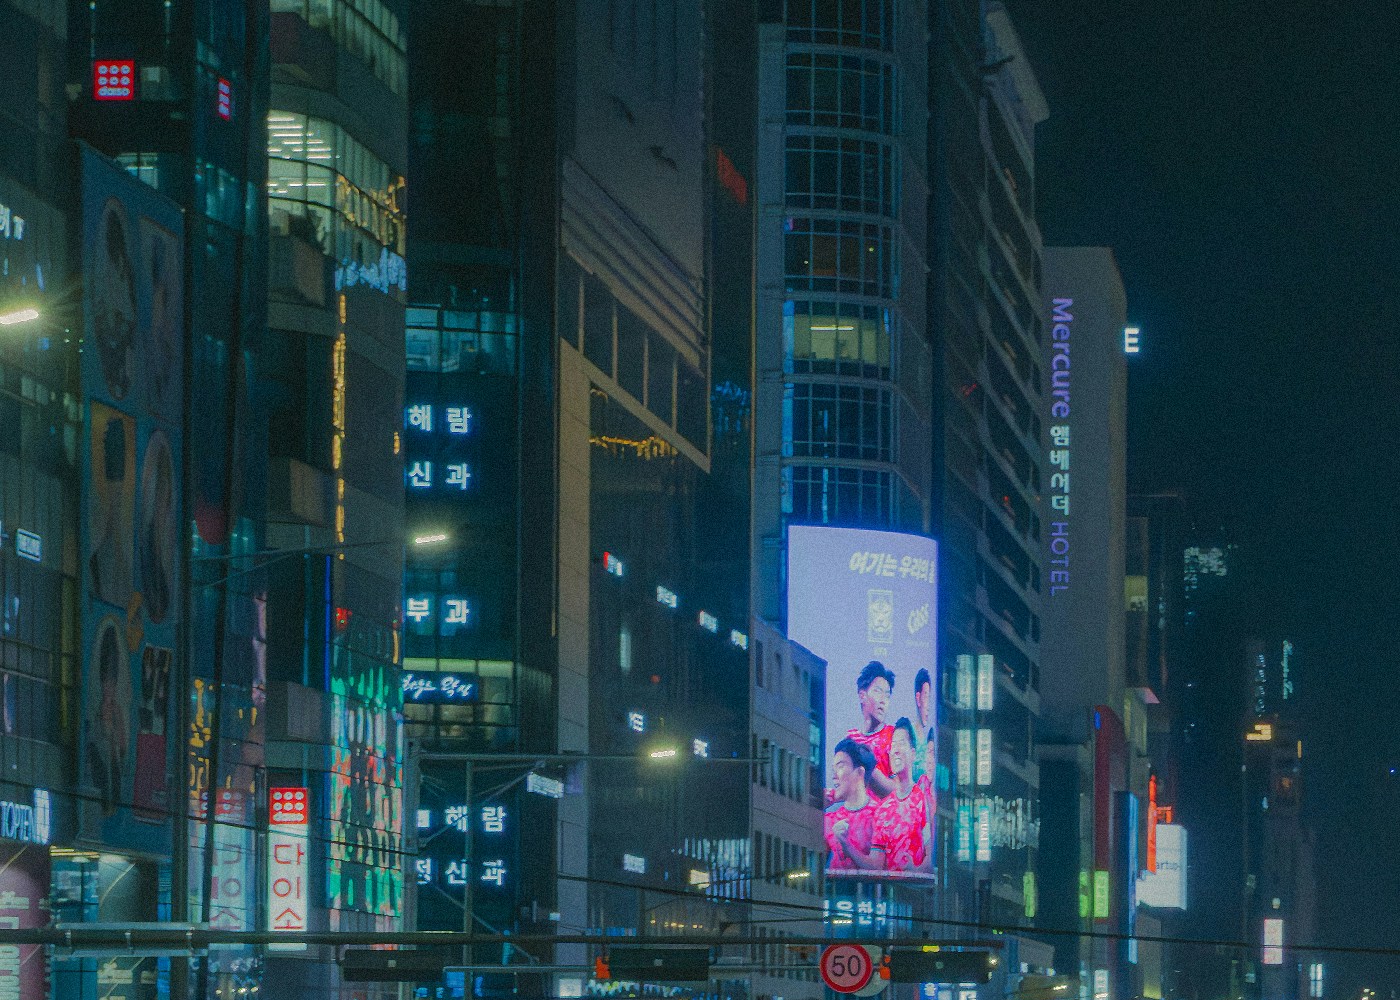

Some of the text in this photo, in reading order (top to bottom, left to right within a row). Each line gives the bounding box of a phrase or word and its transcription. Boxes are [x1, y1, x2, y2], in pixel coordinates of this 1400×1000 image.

[1051, 298, 1073, 418] Mercure
[849, 551, 897, 577] 여기는
[1049, 522, 1069, 597] HOTEL
[273, 844, 305, 929] 다이소
[832, 955, 861, 977] 50
